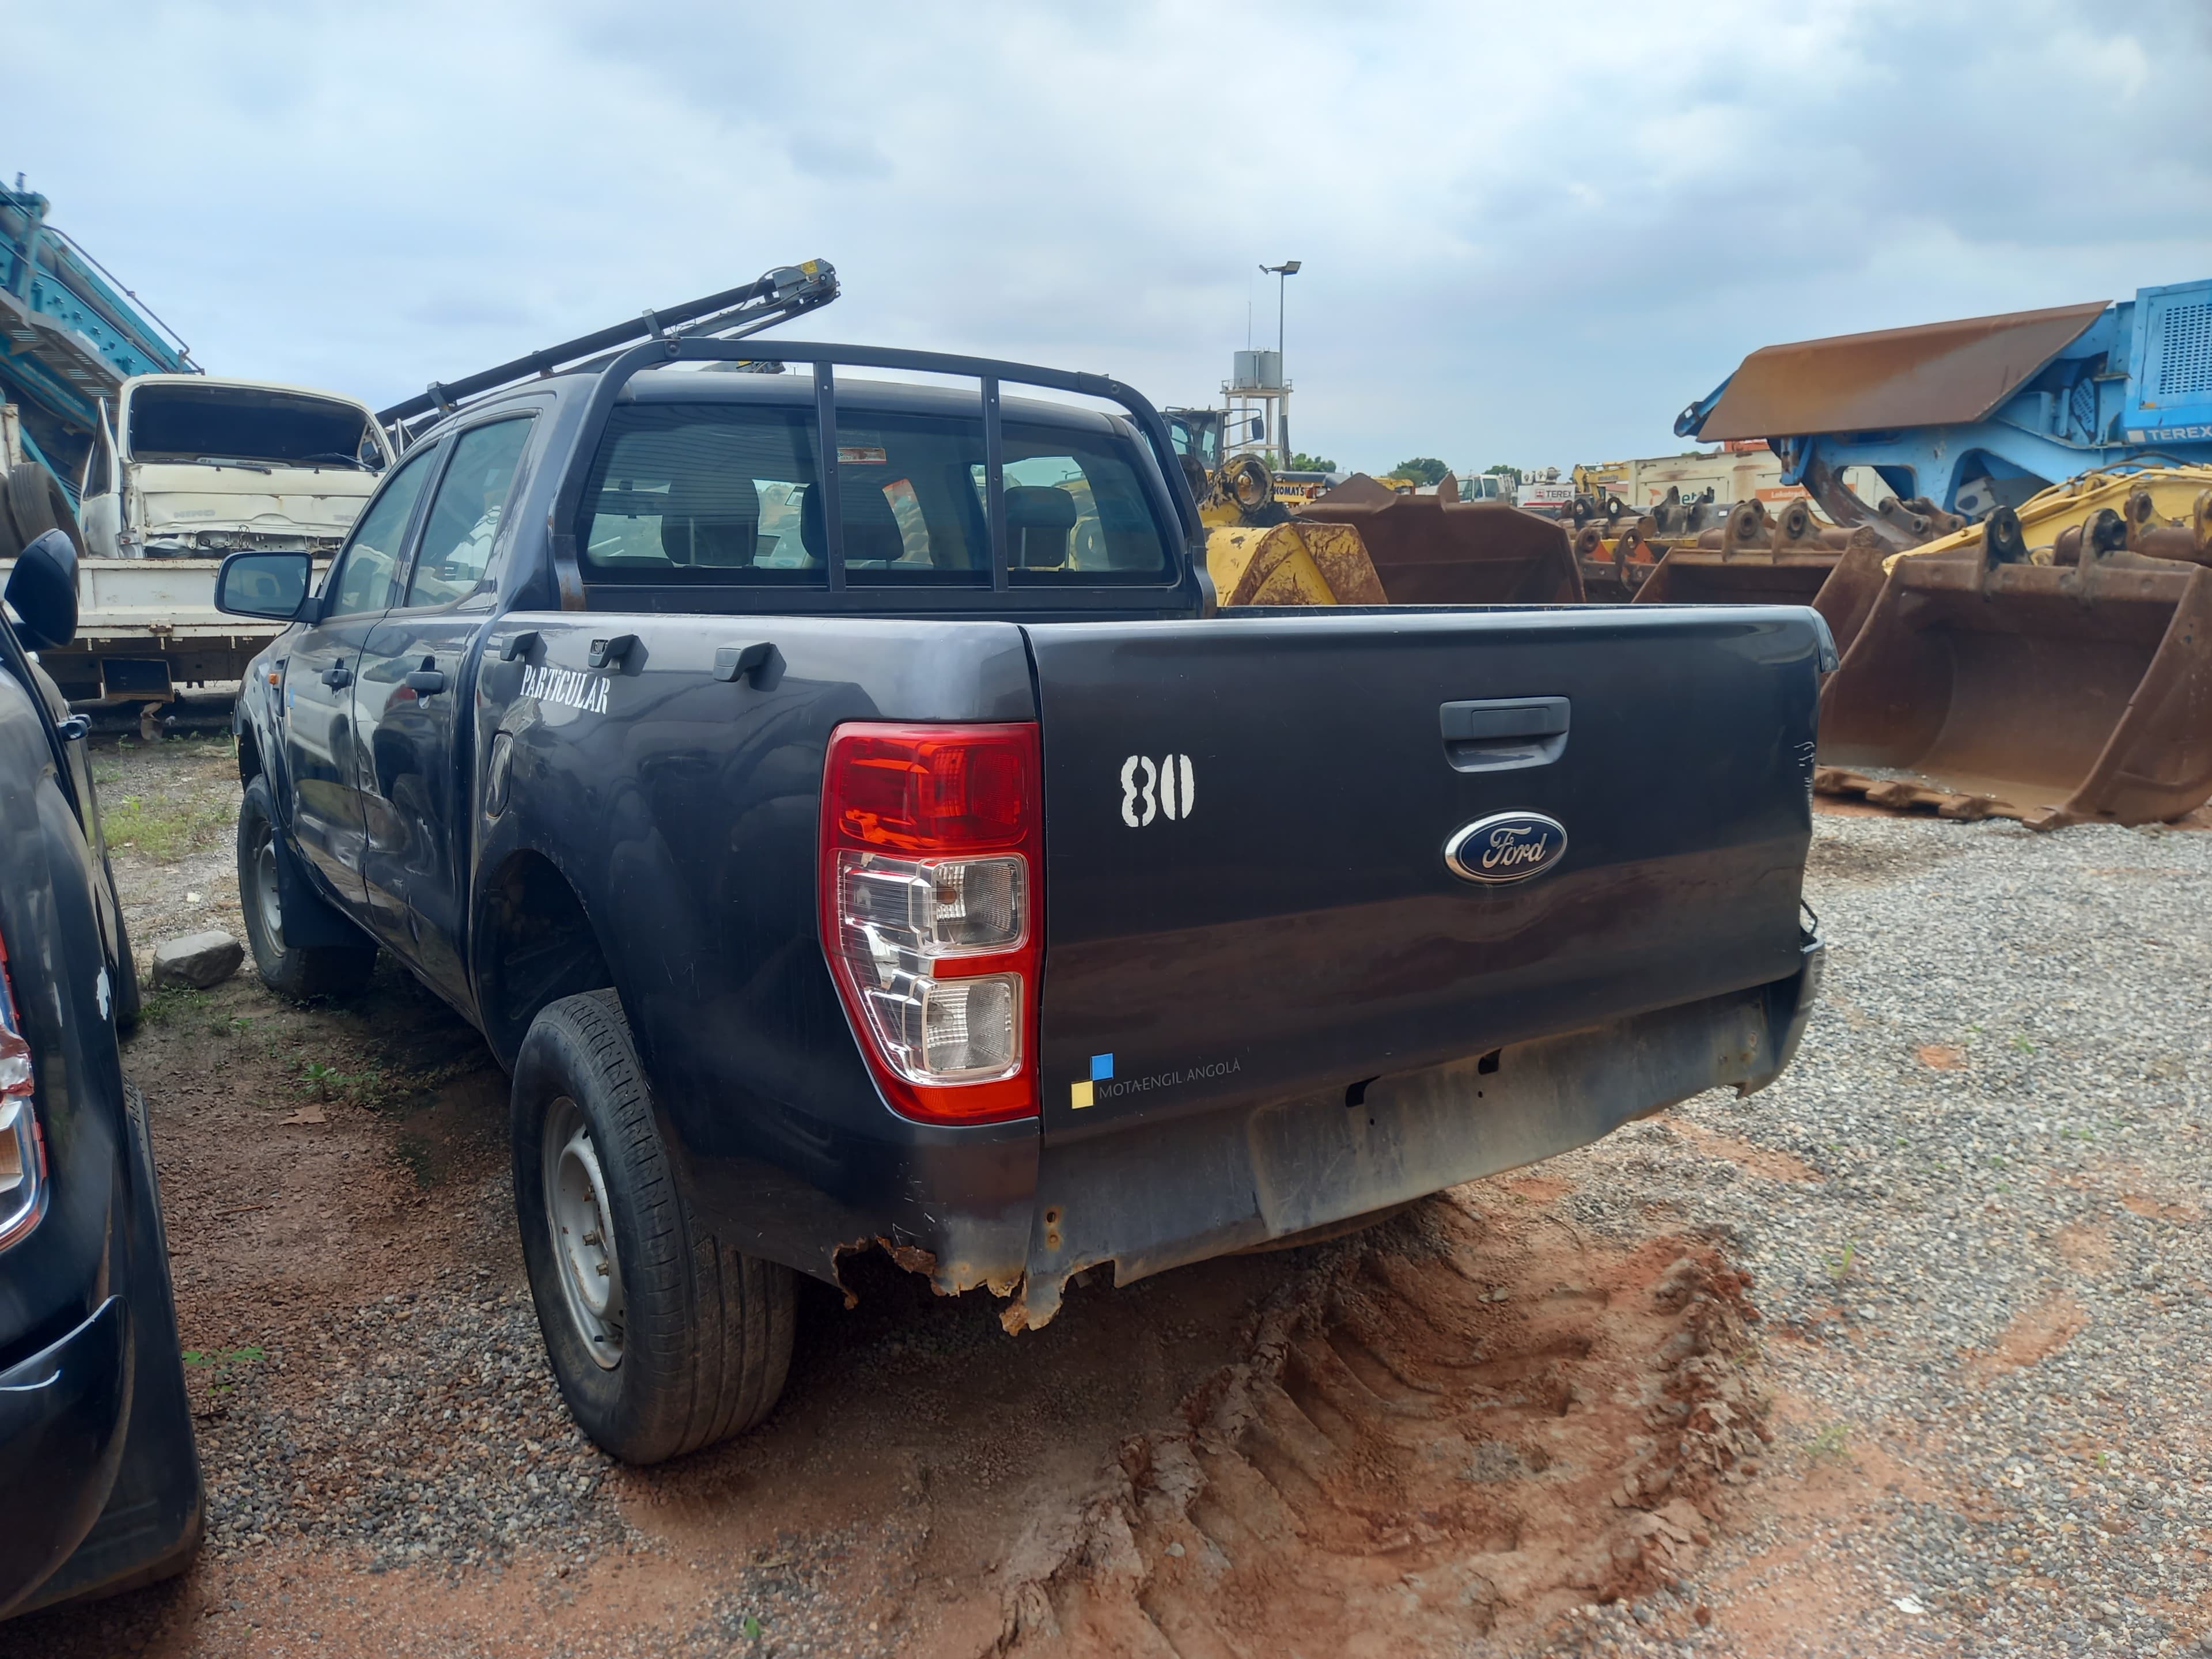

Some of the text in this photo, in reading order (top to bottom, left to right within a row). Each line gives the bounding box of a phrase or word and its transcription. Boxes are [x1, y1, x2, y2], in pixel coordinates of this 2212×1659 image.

[2147, 426, 2212, 441] TEREX
[1272, 486, 1304, 496] KOMATS
[1121, 753, 1194, 827] 80
[1482, 827, 1548, 868] Ford
[1187, 1058, 1241, 1081] ANGOLA
